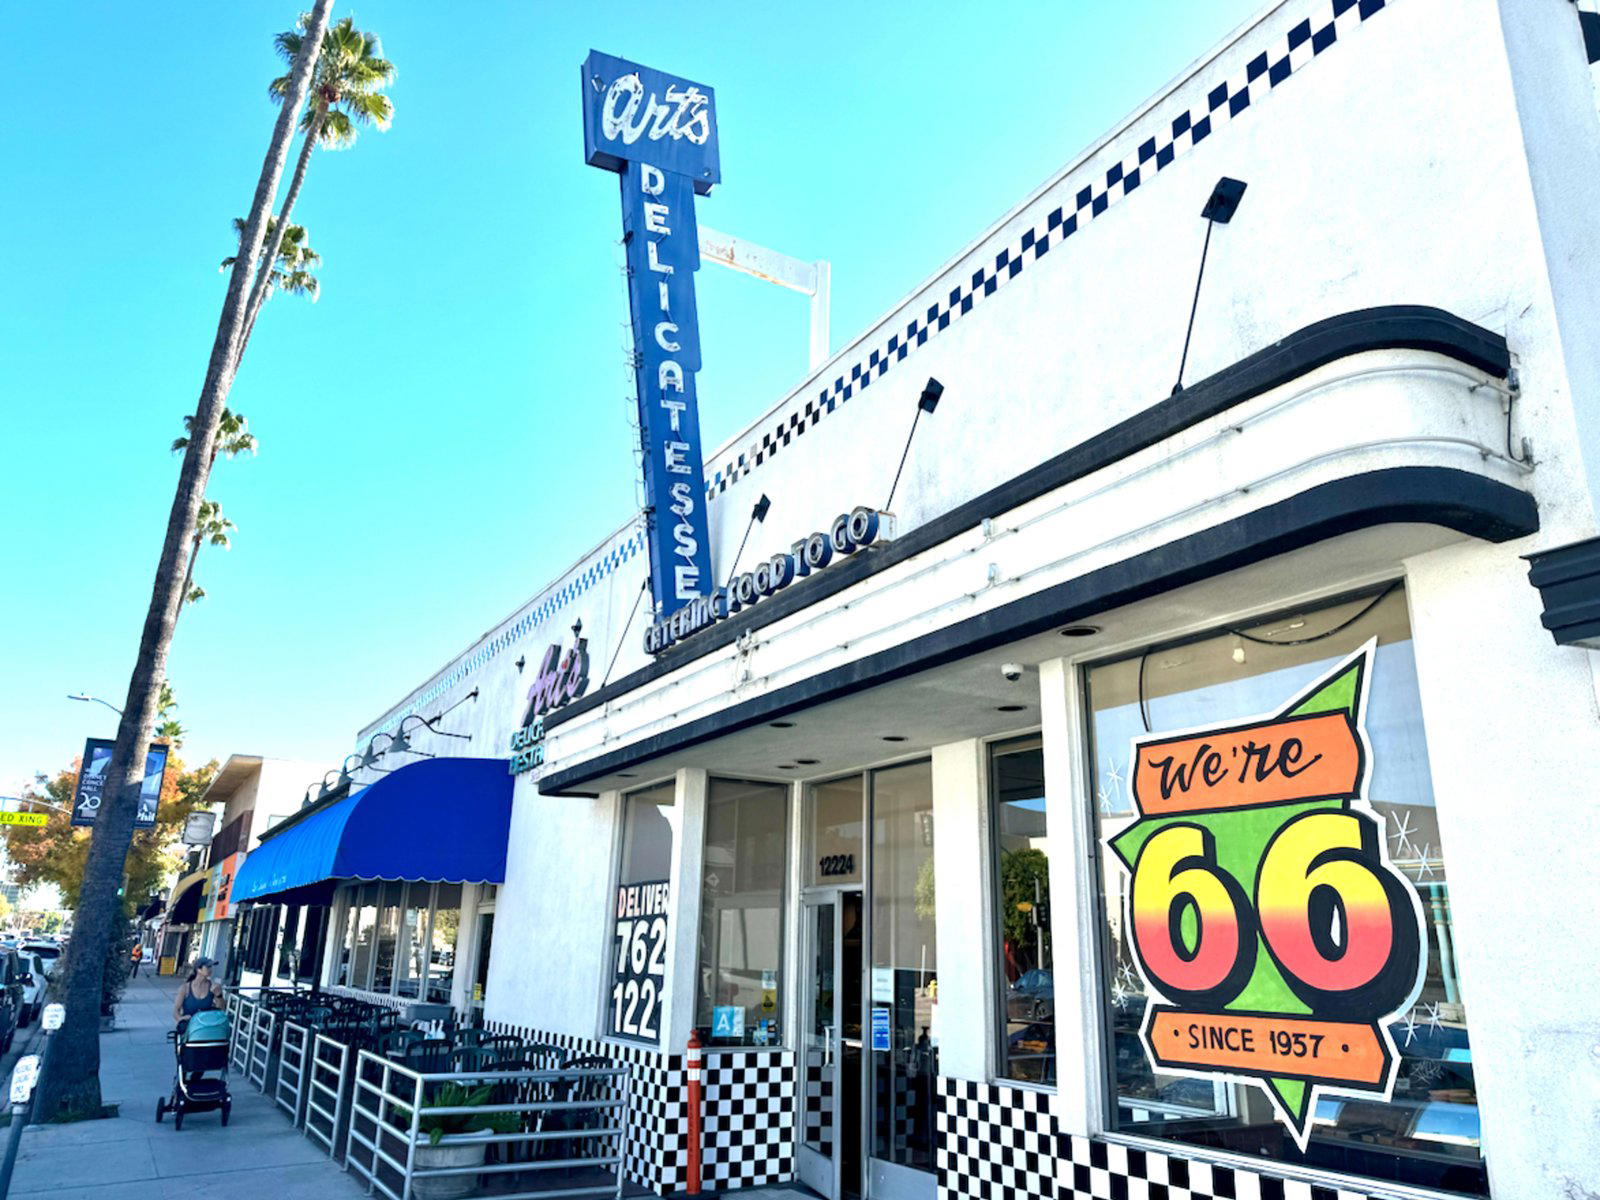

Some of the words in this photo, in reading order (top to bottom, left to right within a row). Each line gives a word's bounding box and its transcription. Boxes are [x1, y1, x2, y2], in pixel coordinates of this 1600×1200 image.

[643, 588, 728, 655] CATERING
[727, 553, 795, 613] FOOD
[791, 531, 833, 578] TO
[829, 505, 879, 555] GO
[1148, 737, 1323, 800] We're
[78, 792, 101, 809] 20
[19, 815, 43, 825] XING
[819, 853, 855, 877] 12224
[1133, 808, 1418, 1002] 66
[616, 917, 667, 976] 762
[716, 1013, 731, 1032] A
[1188, 1023, 1255, 1052] SINCE
[1269, 1030, 1325, 1058] 1957
